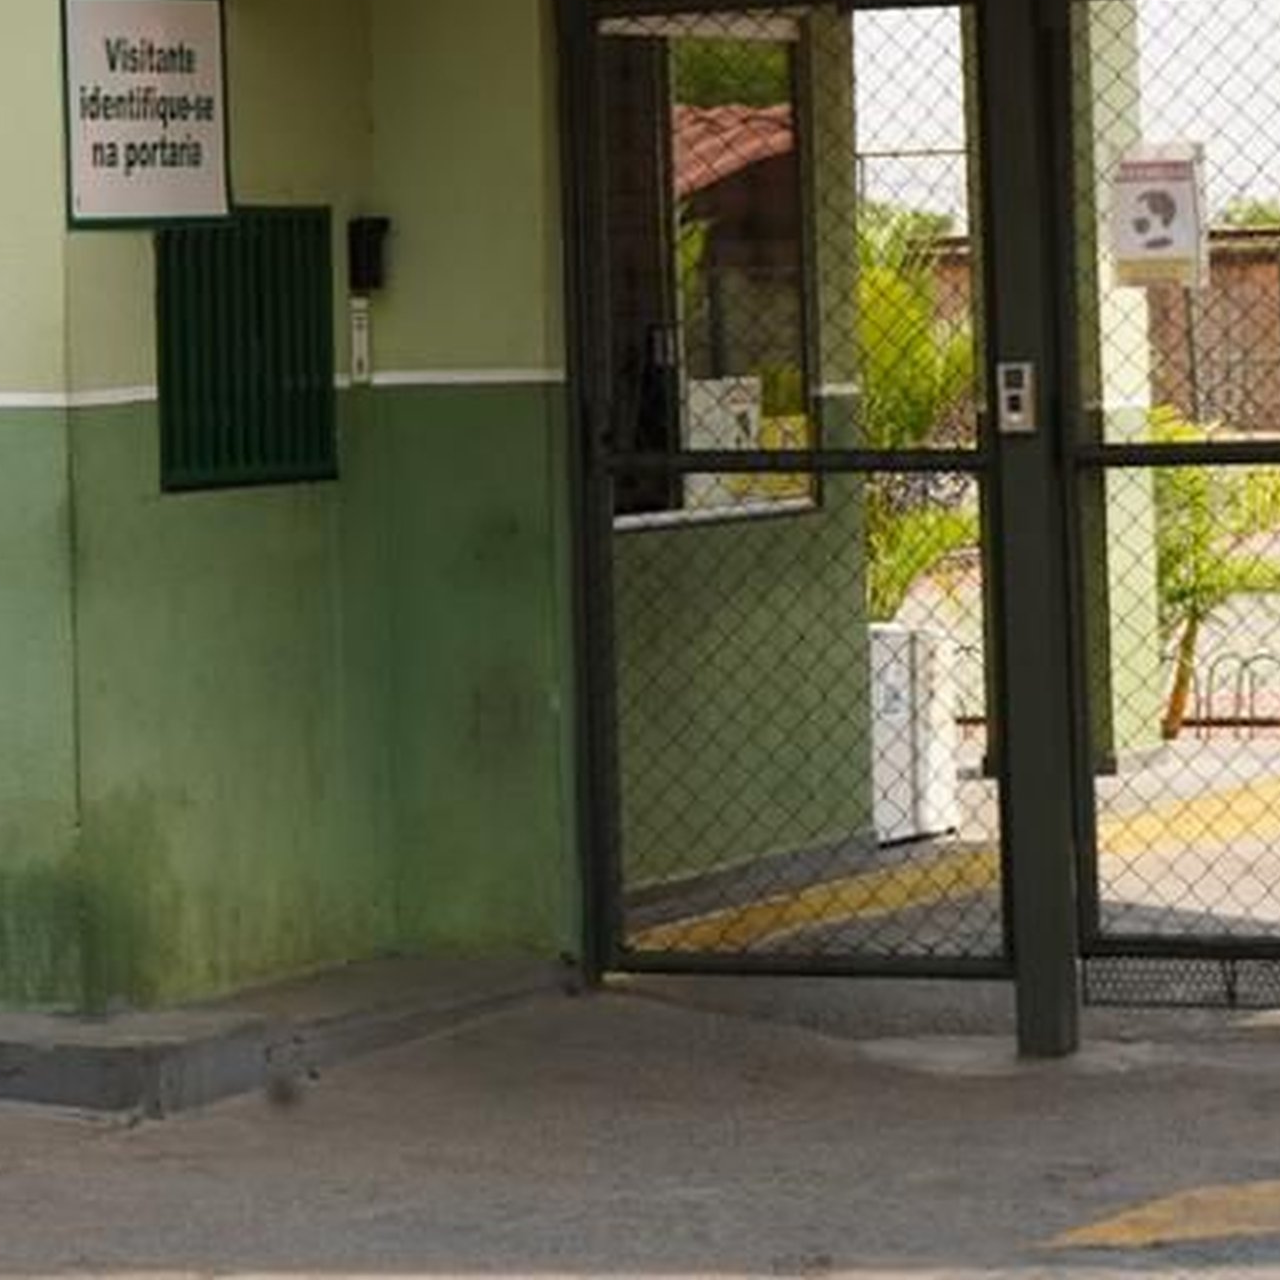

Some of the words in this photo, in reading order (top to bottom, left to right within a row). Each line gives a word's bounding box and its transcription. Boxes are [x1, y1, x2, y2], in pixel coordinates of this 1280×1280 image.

[105, 37, 197, 73] Visitante
[80, 84, 214, 129] identifique-se
[91, 141, 119, 168] na
[124, 133, 202, 177] portaria
